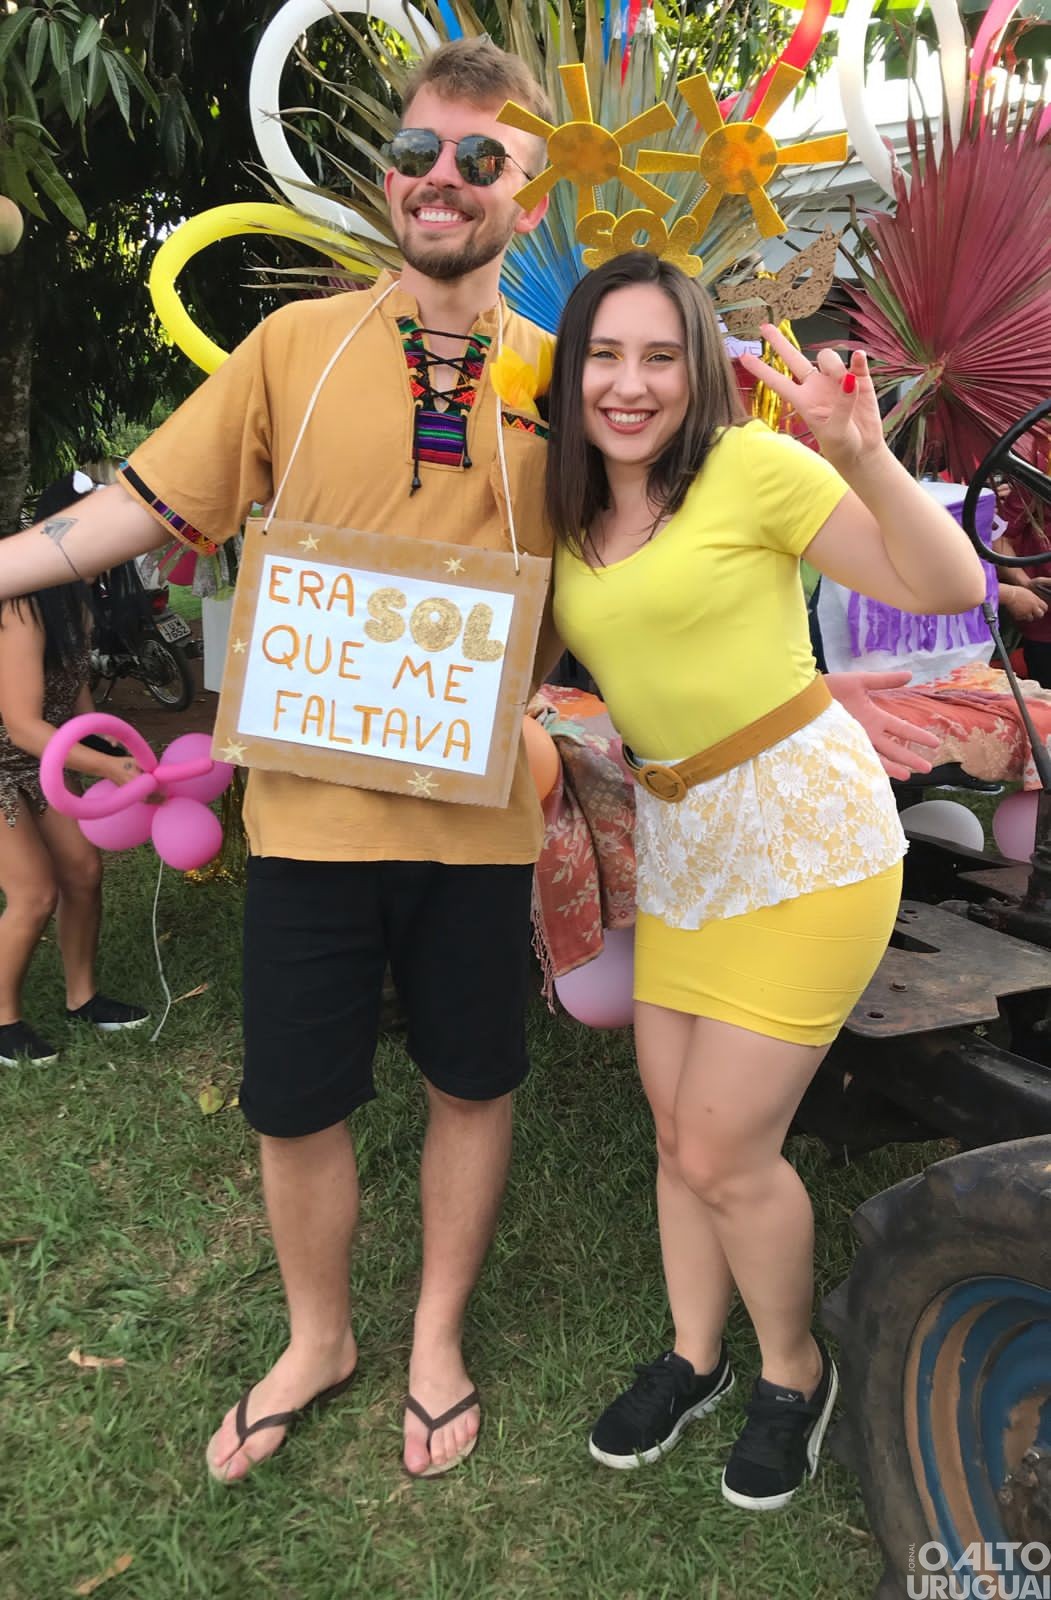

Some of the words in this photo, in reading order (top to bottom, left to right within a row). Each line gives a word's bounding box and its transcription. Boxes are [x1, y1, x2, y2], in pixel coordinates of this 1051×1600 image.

[575, 209, 703, 278] SOL
[268, 564, 355, 617] ERA
[363, 587, 505, 662] SOL
[262, 624, 364, 680] QUE
[392, 655, 474, 704] ME
[273, 690, 471, 762] FALTAVA
